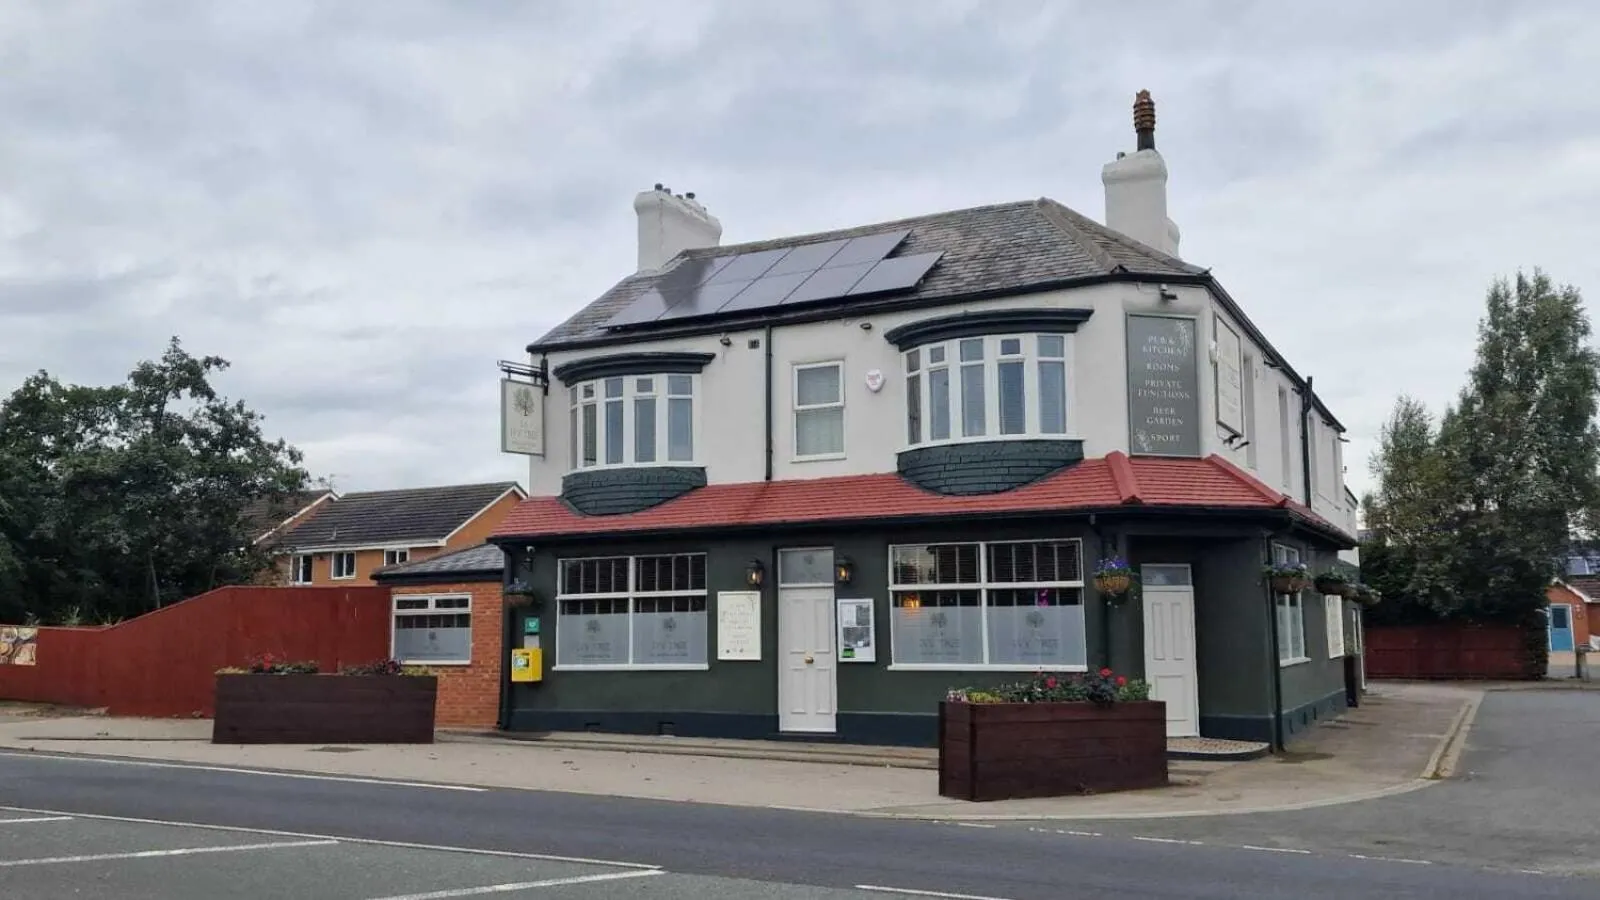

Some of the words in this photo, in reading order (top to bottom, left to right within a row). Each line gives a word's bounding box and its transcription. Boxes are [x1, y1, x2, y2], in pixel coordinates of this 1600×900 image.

[1142, 345, 1184, 355] KITCHEN
[1146, 363, 1180, 372] ROOMS
[1145, 380, 1182, 388] PRIVATE
[1138, 388, 1190, 399] FUNCTIONS
[1153, 407, 1176, 415] BEER
[1145, 416, 1184, 425] GARDEN
[1151, 433, 1181, 441] SPORT
